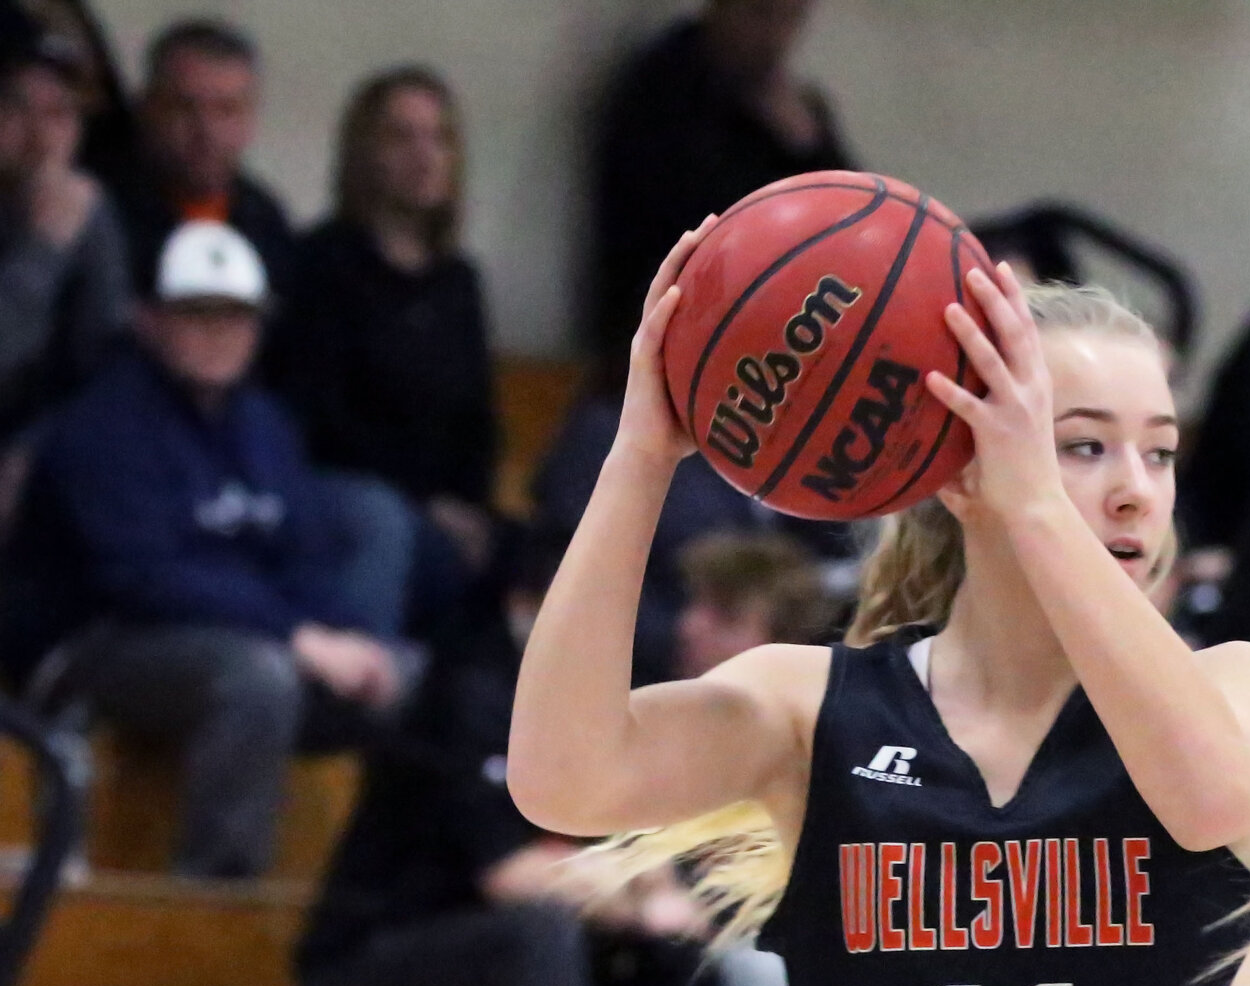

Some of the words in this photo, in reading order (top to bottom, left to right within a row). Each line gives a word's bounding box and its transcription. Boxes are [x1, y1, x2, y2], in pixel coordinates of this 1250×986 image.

[707, 274, 862, 469] Wilson
[801, 358, 920, 502] NCAA
[851, 766, 923, 787] RUSSELL
[839, 837, 1155, 954] WELLSVILLE
